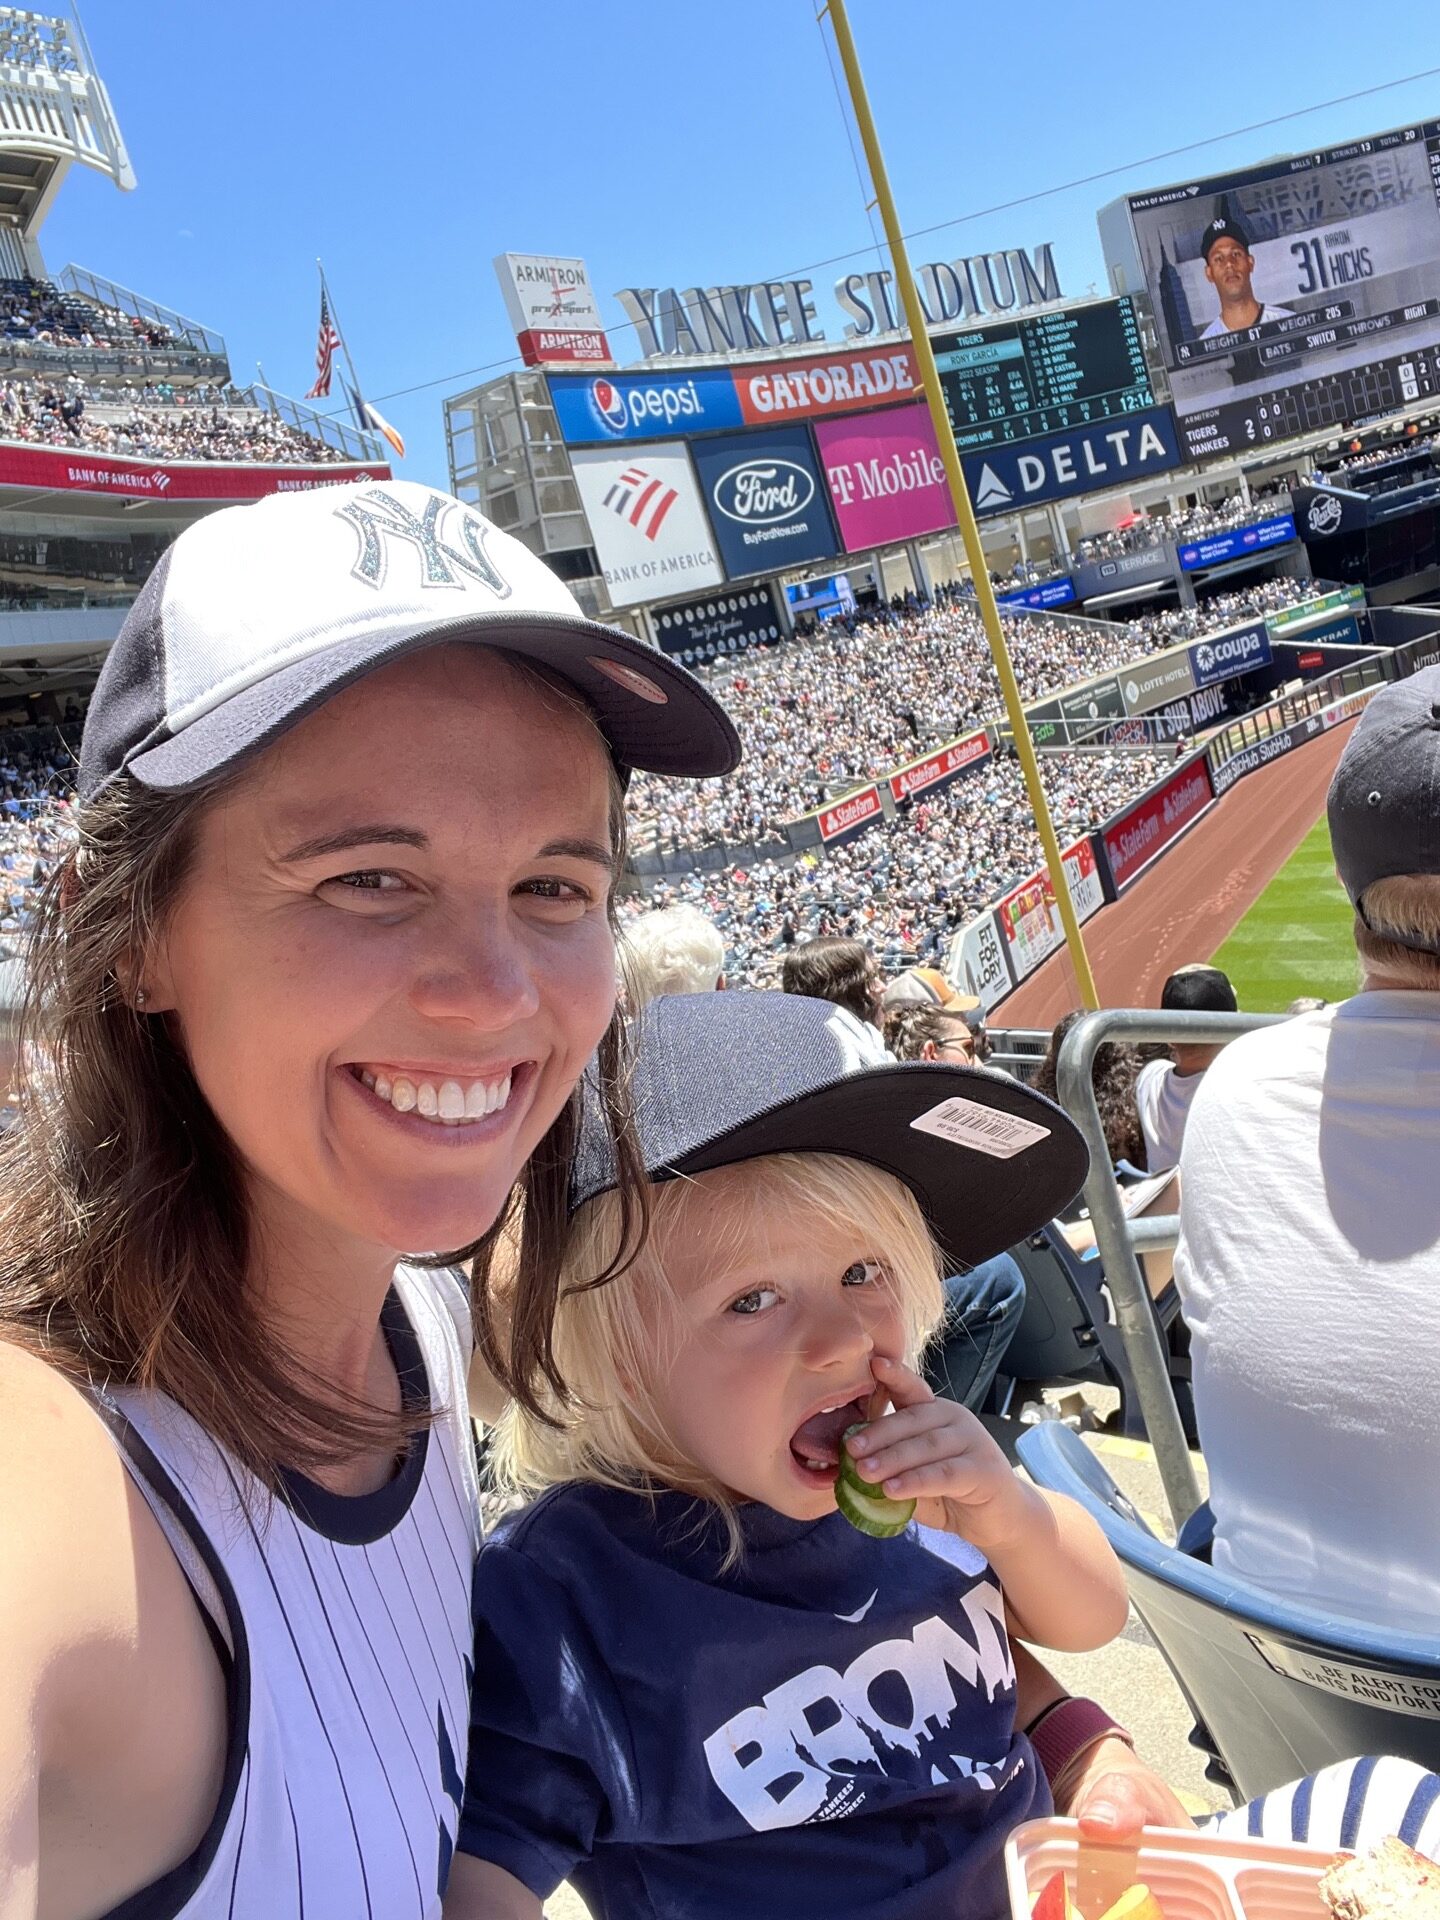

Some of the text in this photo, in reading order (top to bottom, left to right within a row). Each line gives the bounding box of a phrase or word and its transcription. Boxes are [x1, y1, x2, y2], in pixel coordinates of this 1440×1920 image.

[1380, 130, 1416, 147] TOTAL 20
[1290, 155, 1322, 170] BALLS 7
[1332, 143, 1371, 160] STRIKES 13
[1132, 191, 1187, 209] BANK OF AMERICA
[1324, 229, 1350, 246] AARON
[516, 264, 585, 285] ARMITRON
[1291, 237, 1329, 294] 31
[1328, 247, 1374, 286] HICKS
[614, 279, 824, 358] YANKEE
[1042, 312, 1065, 323] CASTRO
[1325, 306, 1341, 320] 205
[1045, 320, 1078, 334] TORKELSON
[1307, 330, 1336, 348] SWITCH
[1404, 304, 1427, 321] RIGHT
[540, 333, 601, 350] ARMITRON
[956, 333, 985, 347] TIGERS
[950, 354, 970, 365] RONY
[959, 364, 1000, 380] 2022 SEASON
[1054, 362, 1077, 373] CASTRO
[749, 355, 914, 413] GATORADE
[1048, 376, 1057, 385] 41
[628, 380, 701, 427] pepsi
[1120, 391, 1154, 412] 12:14
[1186, 362, 1427, 442] TIGERS 2 0 0 0 2
[969, 412, 978, 422] 31
[1185, 409, 1220, 424] ARMITRON
[1189, 380, 1430, 457] YANKEES 0 0 1
[1017, 423, 1166, 492] DELTA
[68, 467, 152, 489] BANK OF AMERICA
[829, 449, 946, 506] T Mobile
[734, 467, 798, 516] Ford
[332, 488, 513, 600] NY
[743, 523, 808, 546] BuyFordNow.com
[605, 551, 716, 585] BANK OF AMERICA
[1119, 551, 1160, 570] TERRACE
[1214, 630, 1260, 661] coupa
[1140, 666, 1190, 693] LOTTE HOTELS
[1154, 683, 1228, 740] A SUB ABOVE
[954, 741, 983, 761] StateFarm
[1260, 735, 1292, 761] StubHub
[908, 762, 940, 790] StateFarm
[837, 796, 874, 823] StateFarm
[1171, 775, 1205, 819] StateFarm
[1119, 814, 1160, 862] StateFarm
[979, 924, 993, 946] FIT
[978, 941, 999, 968] FOR
[976, 957, 1002, 989] LORY
[1302, 1667, 1348, 1692] BATS
[1320, 1664, 1345, 1681] BE
[1351, 1672, 1408, 1694] ALERT
